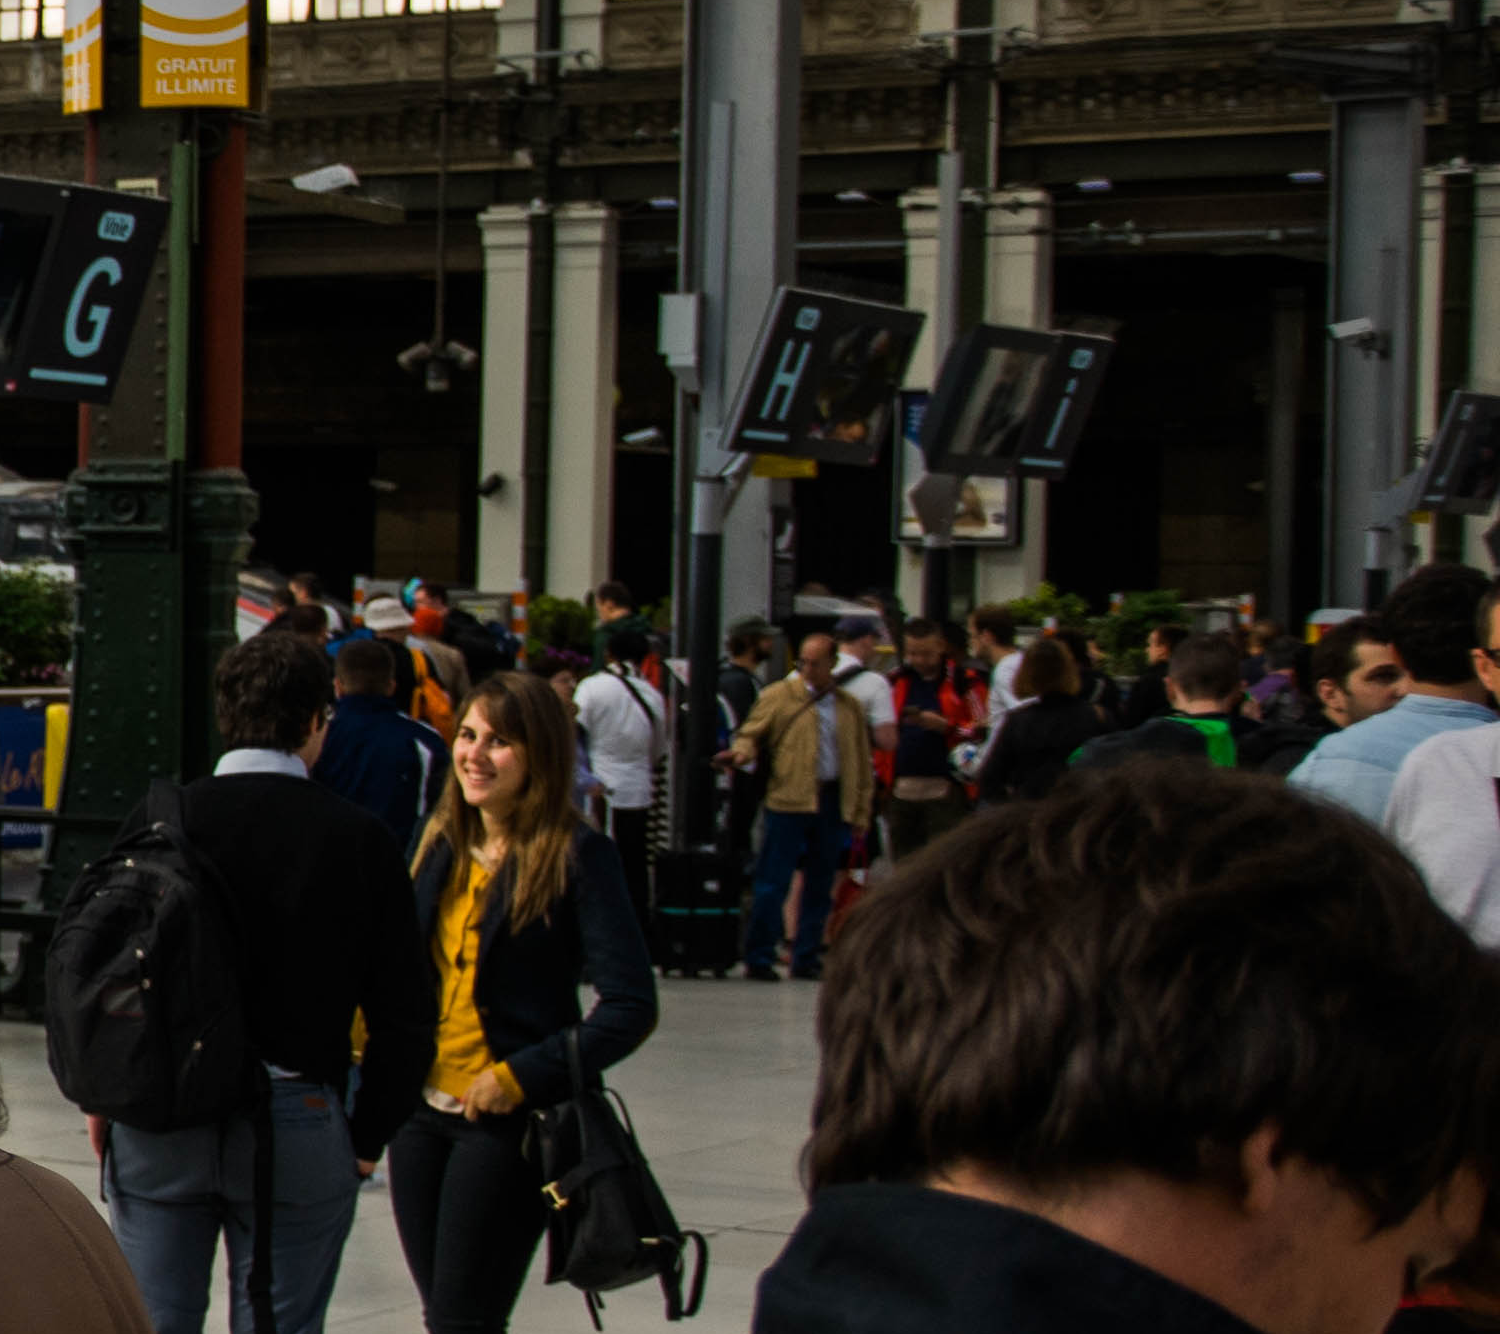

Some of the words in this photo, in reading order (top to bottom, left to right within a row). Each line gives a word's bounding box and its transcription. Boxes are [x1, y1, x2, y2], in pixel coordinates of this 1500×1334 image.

[156, 57, 237, 75] GRATUIT
[62, 256, 123, 359] G
[758, 337, 813, 422] H
